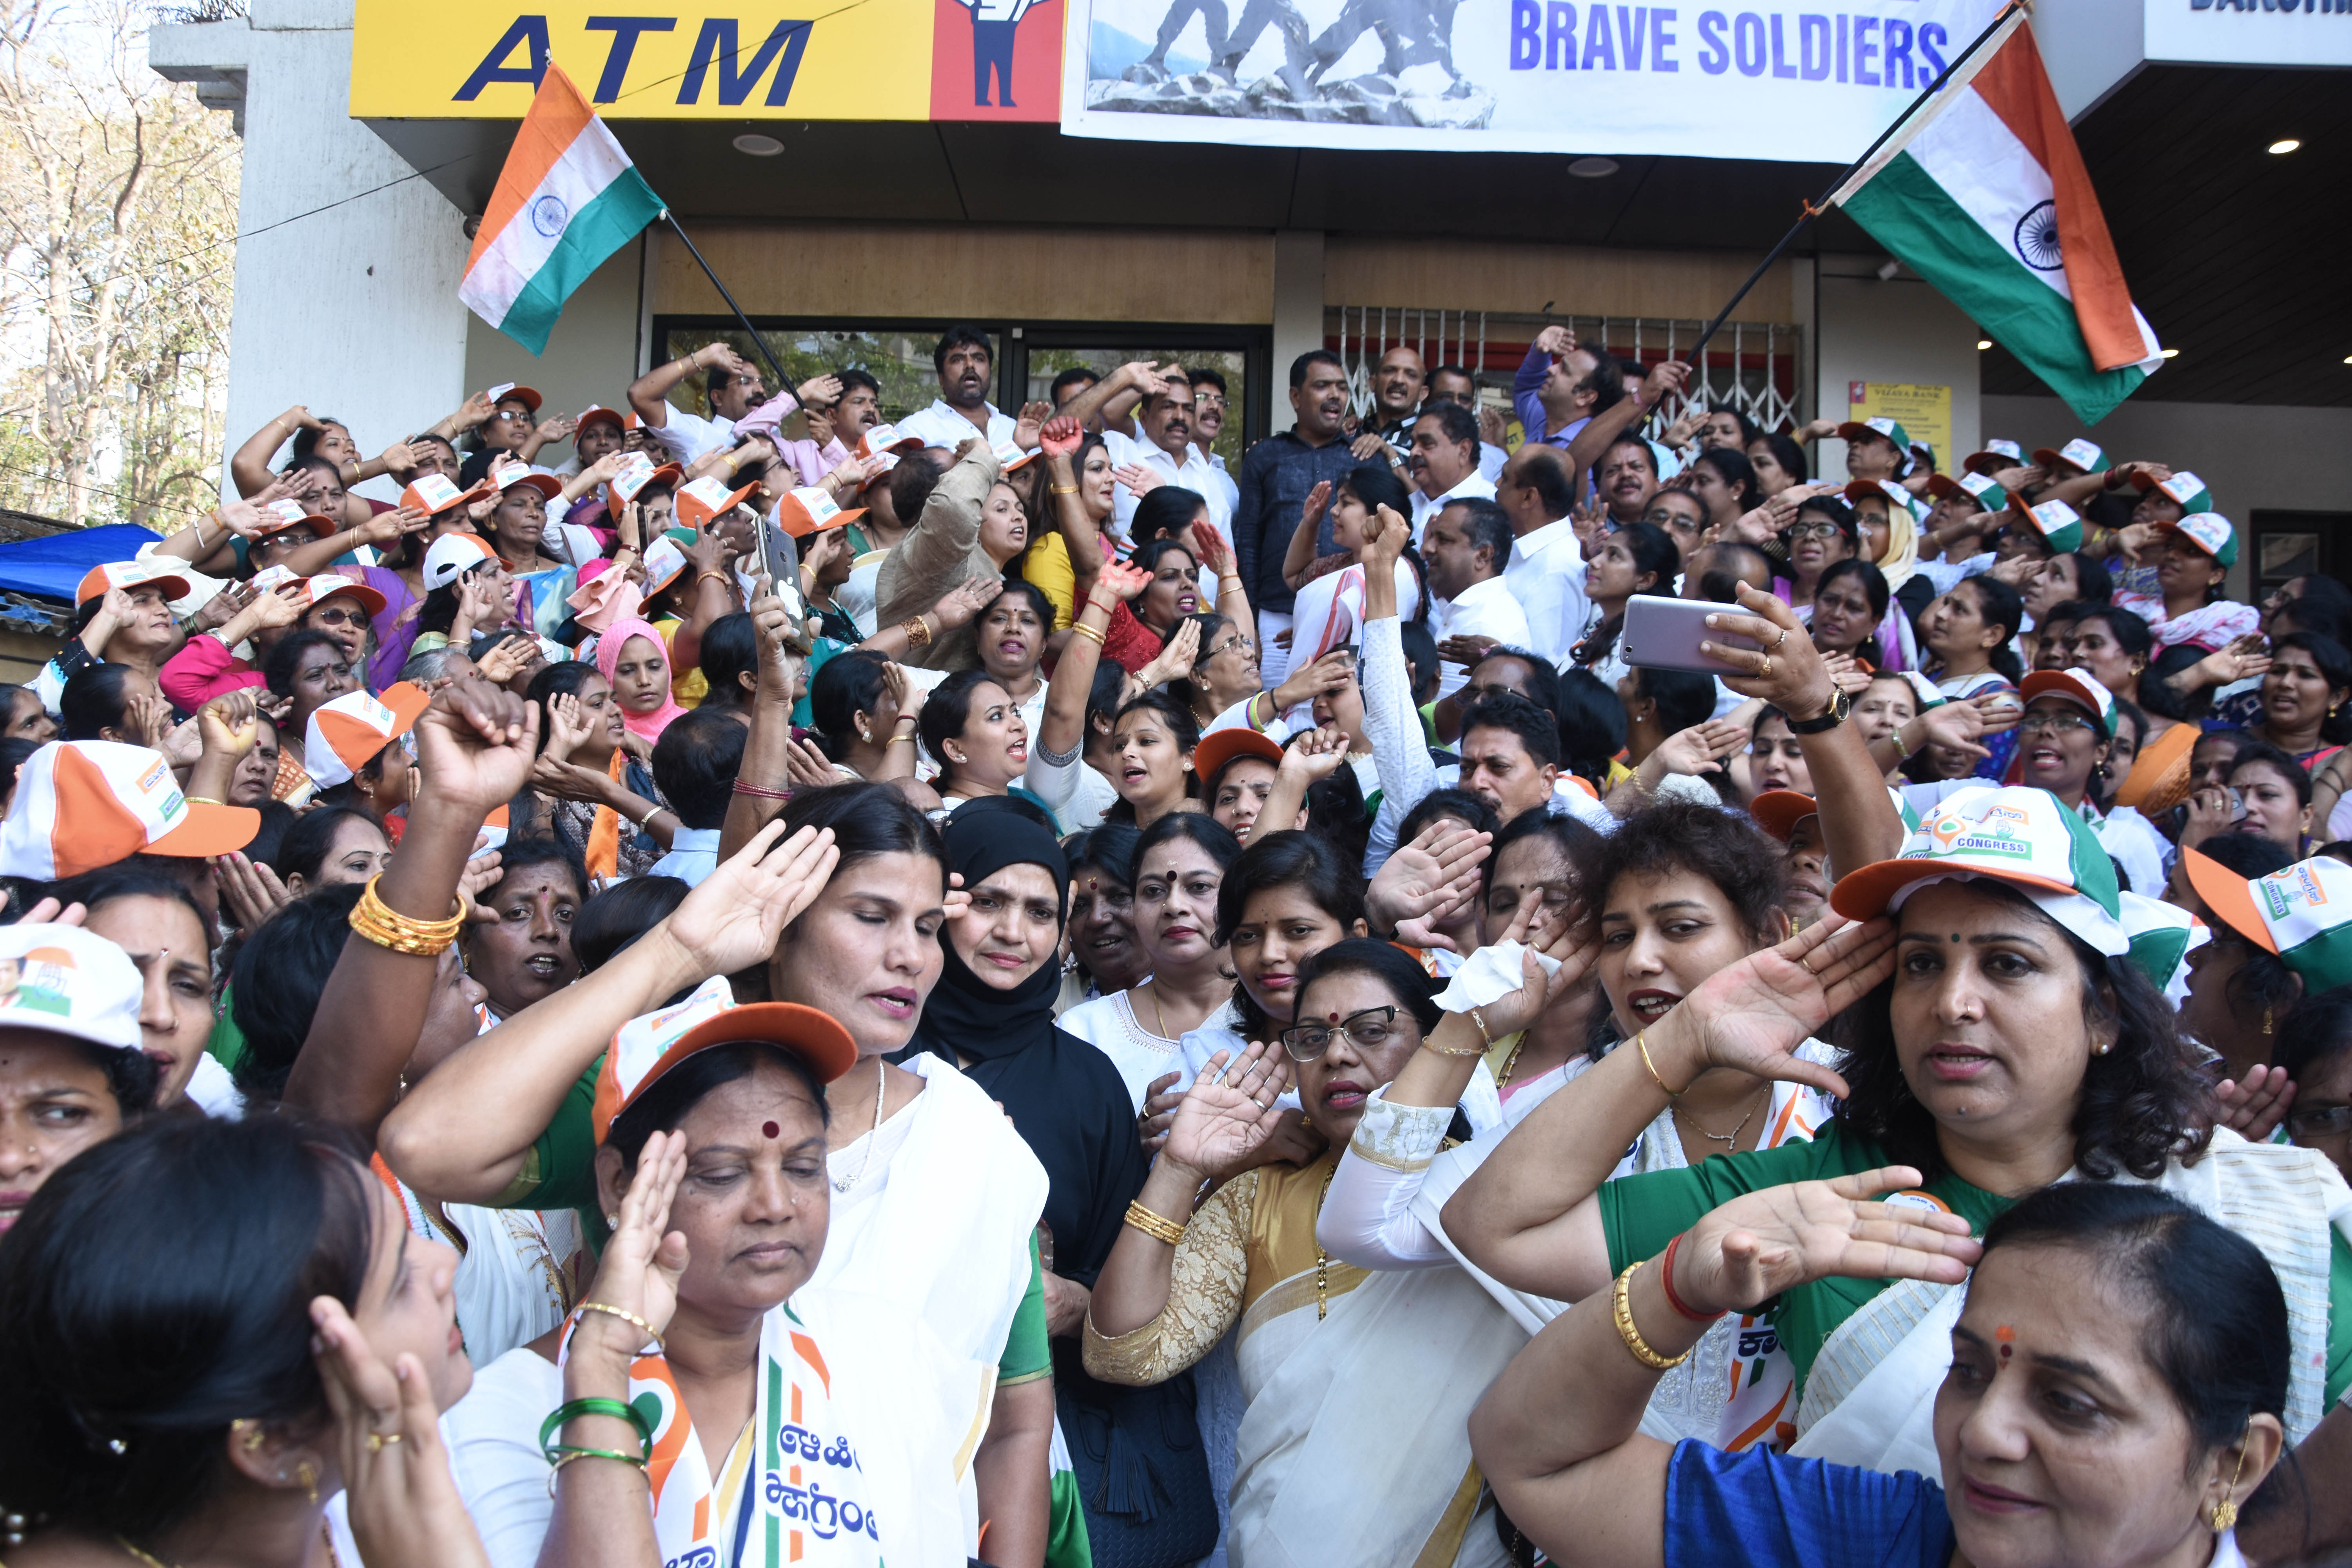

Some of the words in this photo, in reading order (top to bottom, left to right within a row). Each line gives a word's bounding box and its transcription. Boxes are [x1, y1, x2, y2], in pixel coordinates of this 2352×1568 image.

[452, 15, 814, 107] ATM
[1509, 0, 1679, 72] BRAVE
[1697, 10, 1948, 91] SOLDIERS
[1958, 838, 2025, 852] CONGRESS
[2266, 880, 2284, 914] CONGRESS
